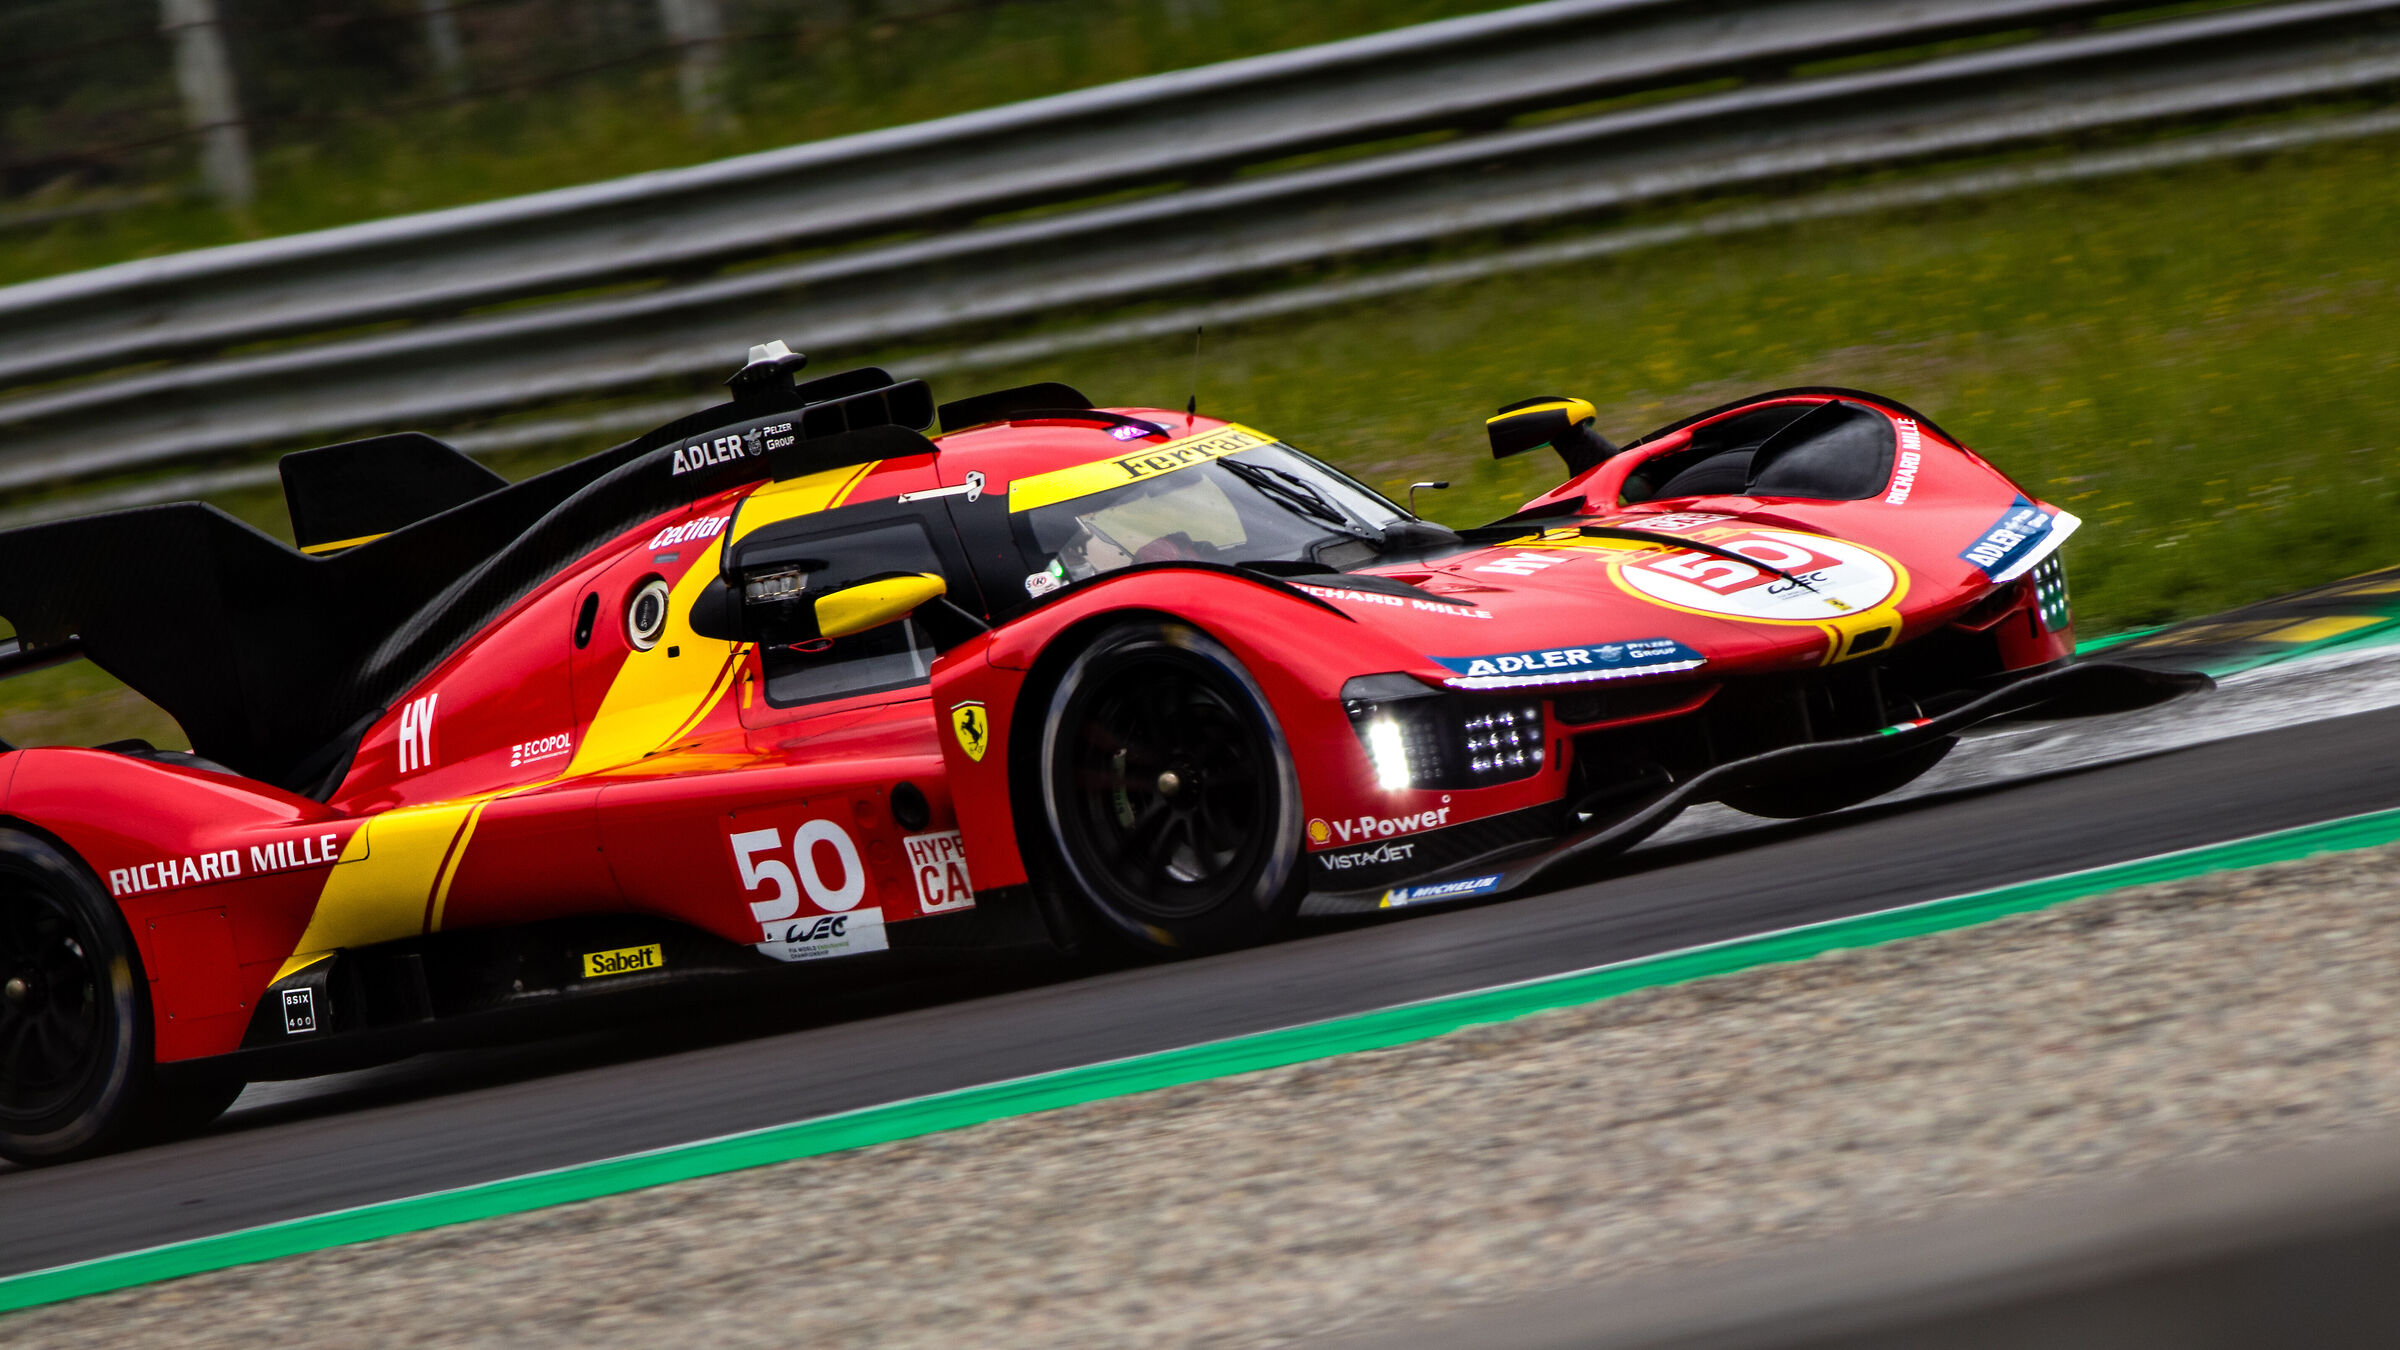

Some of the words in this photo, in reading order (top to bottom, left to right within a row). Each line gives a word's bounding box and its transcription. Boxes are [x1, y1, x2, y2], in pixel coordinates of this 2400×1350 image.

[763, 422, 793, 437] PELZER
[766, 435, 796, 451] GROUP
[1898, 417, 1921, 451] MILLE
[672, 435, 745, 475] ADLER
[1112, 428, 1268, 479] Ferrari
[1885, 452, 1921, 505] RICHARD
[649, 516, 730, 550] Cetilar
[1966, 529, 2027, 568] ADLER
[1473, 552, 1568, 576] HY
[1648, 539, 1814, 589] 50
[1294, 586, 1404, 606] ICHARD
[1412, 600, 1494, 619] MILLE
[1467, 649, 1593, 677] ADLER
[400, 693, 438, 773] HY
[524, 733, 571, 758] ECOPOL
[1333, 806, 1450, 842] V-Power
[109, 850, 241, 896] RICHARD
[250, 834, 338, 872] MILLE
[730, 819, 865, 923] 50
[1412, 876, 1497, 897] MICHELIN
[786, 915, 848, 943] WEC
[592, 947, 654, 974] Sabelt
[286, 994, 309, 1005] 8SIX
[289, 1017, 312, 1027] 400
